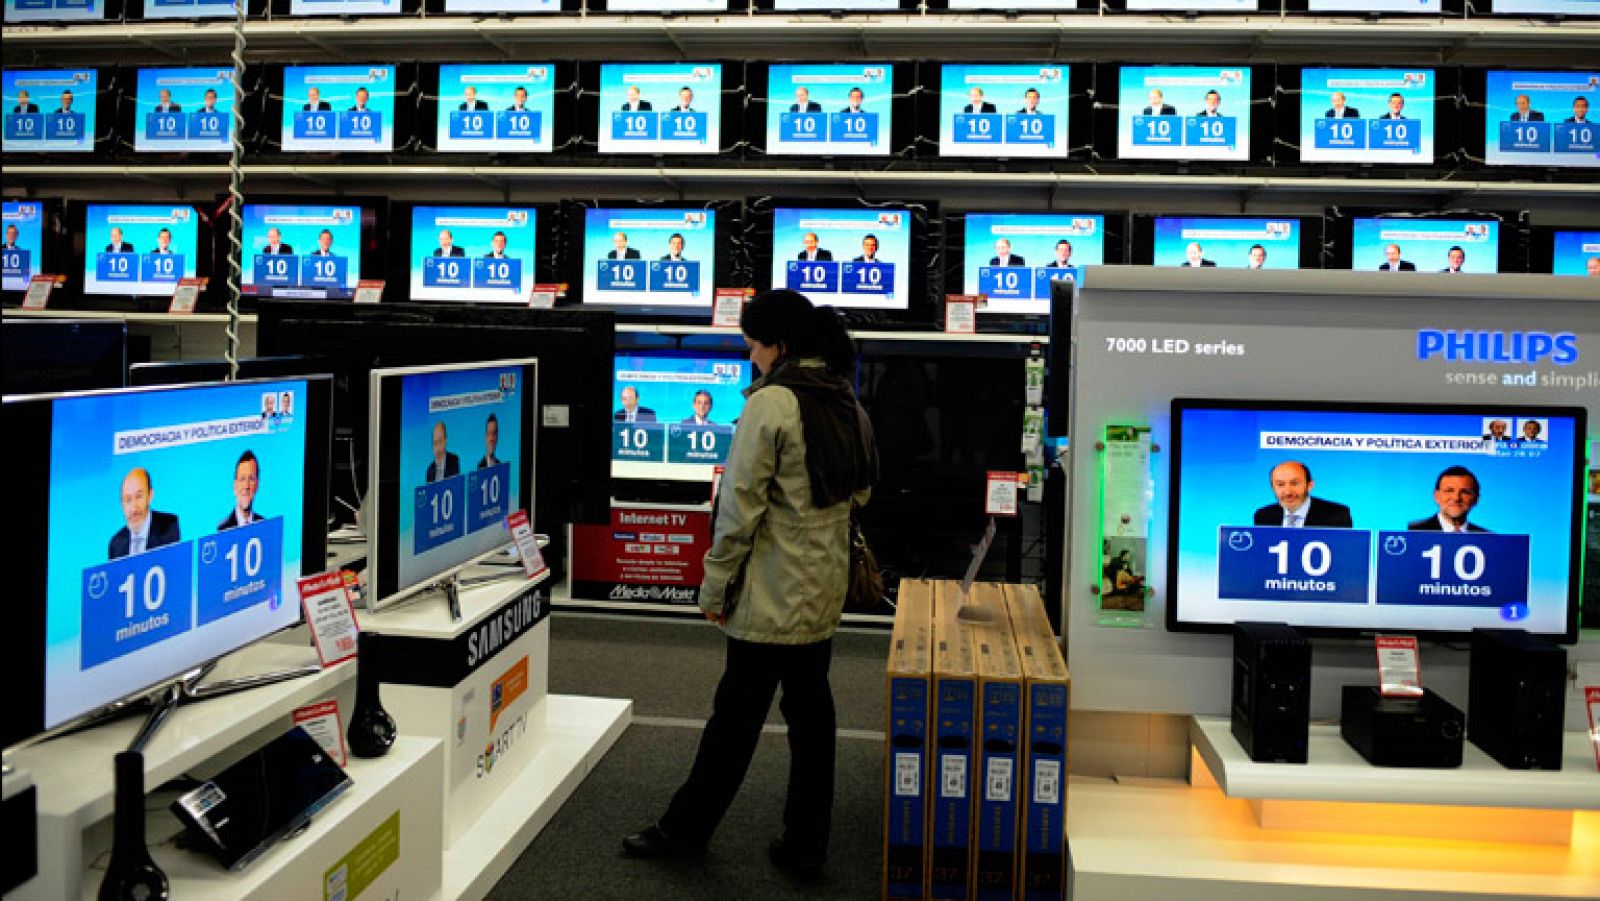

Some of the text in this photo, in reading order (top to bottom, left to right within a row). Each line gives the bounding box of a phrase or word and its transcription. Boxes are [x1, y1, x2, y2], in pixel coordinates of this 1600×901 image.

[16, 118, 33, 132] 10
[57, 116, 75, 132] 10
[158, 116, 175, 132] 10
[201, 116, 219, 131] 10
[306, 116, 325, 130] 10
[351, 115, 371, 131] 10
[463, 115, 482, 130] 10
[510, 115, 529, 130] 10
[626, 116, 646, 132] 10
[674, 116, 696, 132] 10
[794, 116, 815, 132] 10
[845, 117, 865, 132] 10
[968, 118, 990, 134] 10
[1020, 118, 1042, 134] 10
[1147, 120, 1169, 137] 10
[1201, 120, 1223, 136] 10
[1330, 122, 1352, 139] 10
[1384, 124, 1406, 140] 10
[1516, 126, 1537, 142] 10
[1570, 128, 1591, 142] 10
[109, 257, 127, 272] 10
[154, 258, 173, 273] 10
[266, 259, 287, 275] 10
[315, 260, 335, 277] 10
[437, 261, 458, 279] 10
[488, 262, 508, 278] 10
[612, 264, 634, 280] 10
[664, 265, 686, 283] 10
[801, 266, 825, 282] 10
[857, 266, 881, 285] 10
[995, 272, 1017, 290] 10
[1105, 337, 1245, 356] 7000 LED series
[1417, 329, 1579, 365] PHILIPS
[1445, 372, 1497, 386] sense
[1502, 370, 1537, 387] and
[619, 428, 648, 449] 10
[687, 431, 716, 451] 10
[1265, 435, 1352, 448] DEMOCRACIA
[1354, 437, 1365, 447] Y
[480, 475, 499, 506] 10
[430, 489, 453, 524] 10
[619, 512, 687, 527] Internet TV
[225, 537, 263, 583] 10
[1268, 540, 1332, 577] 10
[1421, 545, 1487, 581] 10
[118, 565, 166, 619] 10
[223, 580, 266, 604] minutos
[1265, 577, 1336, 593] minutos
[1419, 582, 1492, 598] minutos
[1507, 605, 1519, 619] 1
[116, 613, 170, 643] minutos
[467, 589, 541, 667] SAMSUNG
